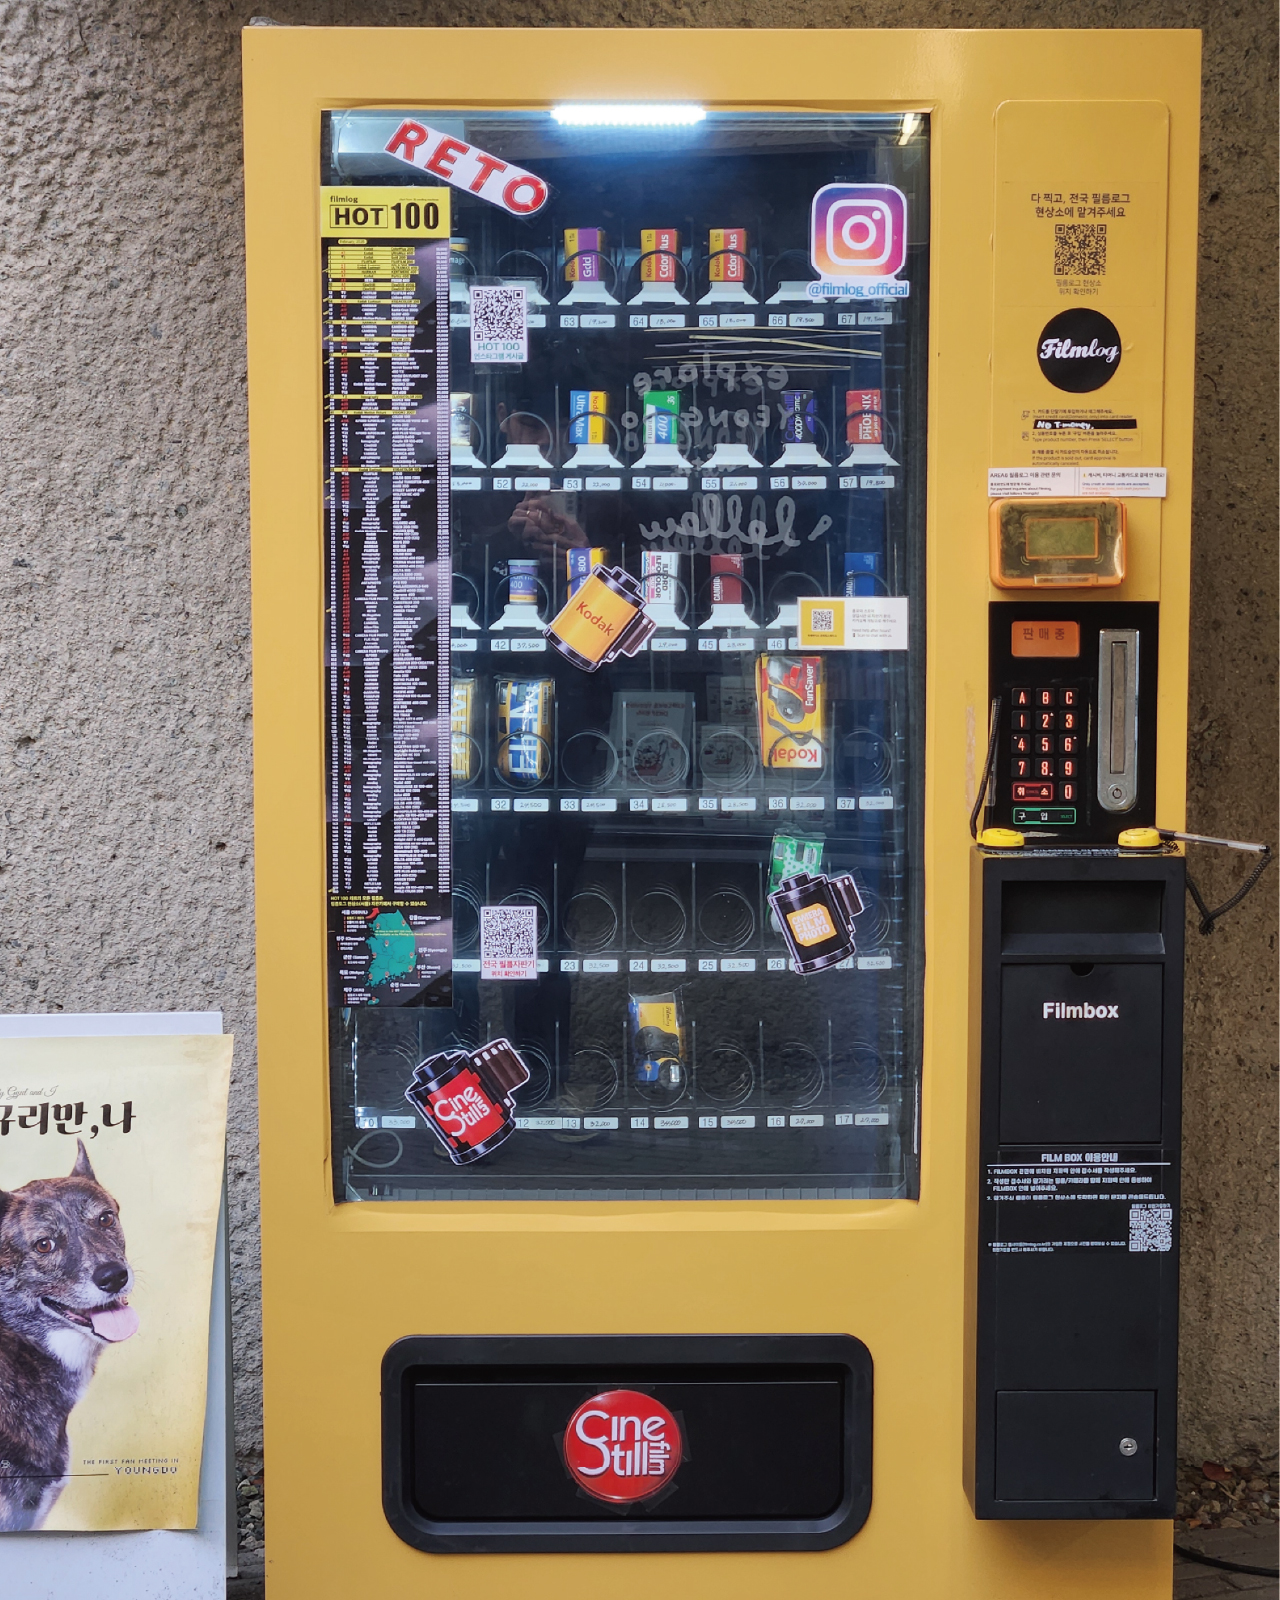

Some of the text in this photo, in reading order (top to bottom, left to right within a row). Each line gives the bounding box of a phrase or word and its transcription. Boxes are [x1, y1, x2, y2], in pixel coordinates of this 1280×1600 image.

[385, 118, 547, 213] RETO
[329, 195, 358, 204] filmlog
[1031, 192, 1131, 204] 다 찍고, 전국 필름로그
[334, 202, 440, 230] HOT 100
[1035, 206, 1074, 218] 현상소에
[808, 282, 909, 298] @filmlog_official
[564, 317, 576, 326] 63
[632, 316, 644, 326] 64
[702, 318, 715, 326] 65
[772, 316, 784, 326] 66
[842, 314, 853, 324] 67
[477, 342, 520, 351] HOT 100
[1039, 338, 1120, 364] Filmlog
[575, 395, 586, 438] UltraMax
[659, 415, 669, 440] 400
[1036, 420, 1052, 429] No
[496, 479, 508, 488] 52
[566, 480, 578, 489] 53
[636, 478, 646, 488] 54
[705, 480, 717, 488] 55
[774, 478, 784, 488] 56
[844, 478, 854, 488] 57
[578, 556, 587, 572] 800
[575, 600, 615, 637] Kodak
[494, 640, 506, 650] 42
[702, 641, 714, 650] 45
[770, 640, 782, 649] 46
[805, 664, 814, 706] FunSaver
[1018, 692, 1073, 704] A B C
[1020, 714, 1072, 728] 1 2 3
[1018, 738, 1072, 751] 4 5 6
[1019, 762, 1072, 774] 7 8 9
[1065, 784, 1072, 800] 0
[494, 800, 506, 810] 32
[564, 800, 576, 810] 33
[632, 800, 644, 810] 34
[702, 800, 714, 809] 35
[772, 798, 784, 808] 36
[840, 799, 852, 808] 37
[792, 908, 824, 925] CAMERA
[794, 916, 826, 934] FILM
[798, 924, 831, 941] PHOTO
[482, 960, 497, 969] 전국
[564, 962, 576, 970] 23
[632, 961, 644, 970] 24
[702, 961, 714, 970] 25
[770, 960, 782, 970] 26
[838, 958, 851, 968] 27
[1042, 1002, 1120, 1019] Filmbox
[434, 1086, 479, 1122] Cine
[362, 1118, 374, 1128] 10
[518, 1119, 530, 1128] 12
[566, 1120, 578, 1128] 13
[634, 1118, 645, 1127] 14
[702, 1118, 714, 1127] 15
[770, 1118, 782, 1126] 16
[838, 1116, 850, 1124] 17
[1041, 1153, 1063, 1162] FILM
[1064, 1153, 1082, 1162] BOX
[576, 1409, 666, 1442] Cine
[577, 1439, 649, 1477] Still
[648, 1440, 672, 1476] film
[115, 1466, 178, 1475] YOUNGDO
